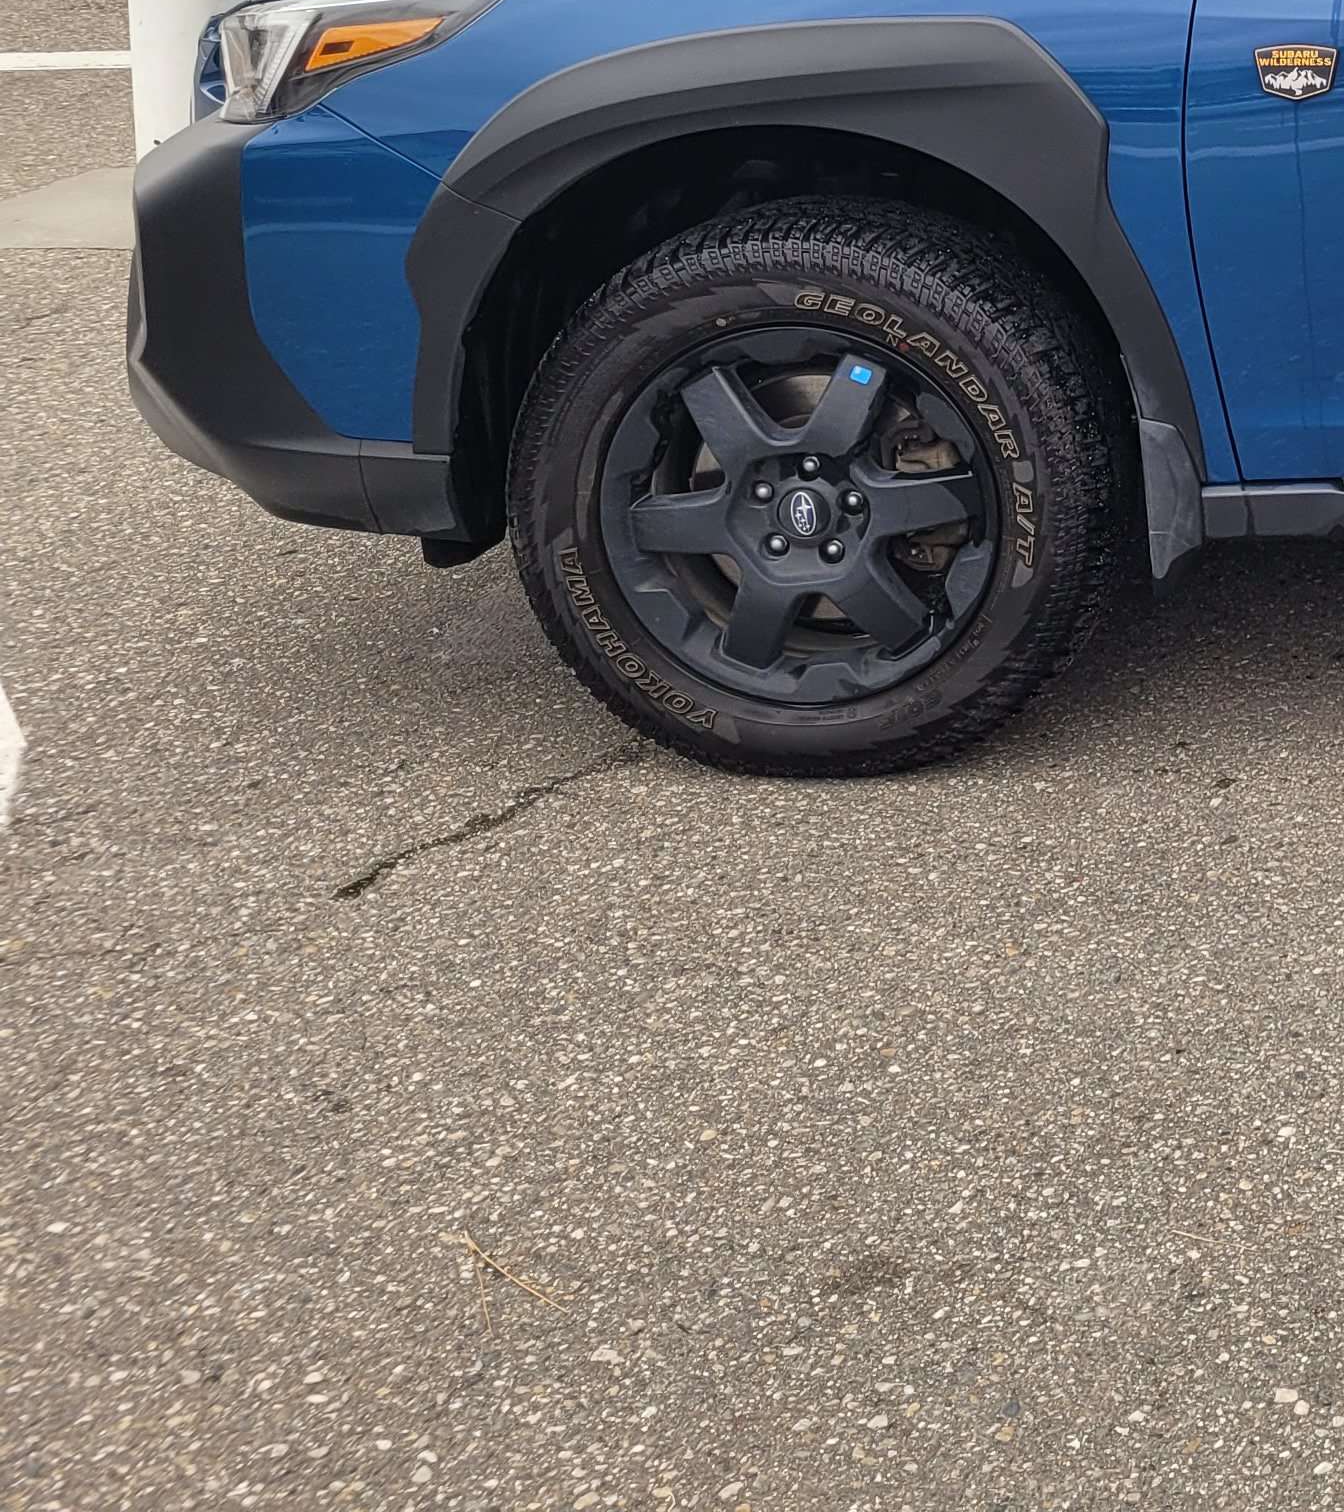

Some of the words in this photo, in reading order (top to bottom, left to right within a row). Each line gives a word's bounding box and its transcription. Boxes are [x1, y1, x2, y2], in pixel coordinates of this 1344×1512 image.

[1259, 57, 1331, 66] WILDERNESS
[1272, 50, 1318, 58] SUBARU
[793, 289, 1019, 460] GEOLANDAR
[1012, 484, 1036, 569] A/T
[559, 545, 721, 730] YOKOHAMA
